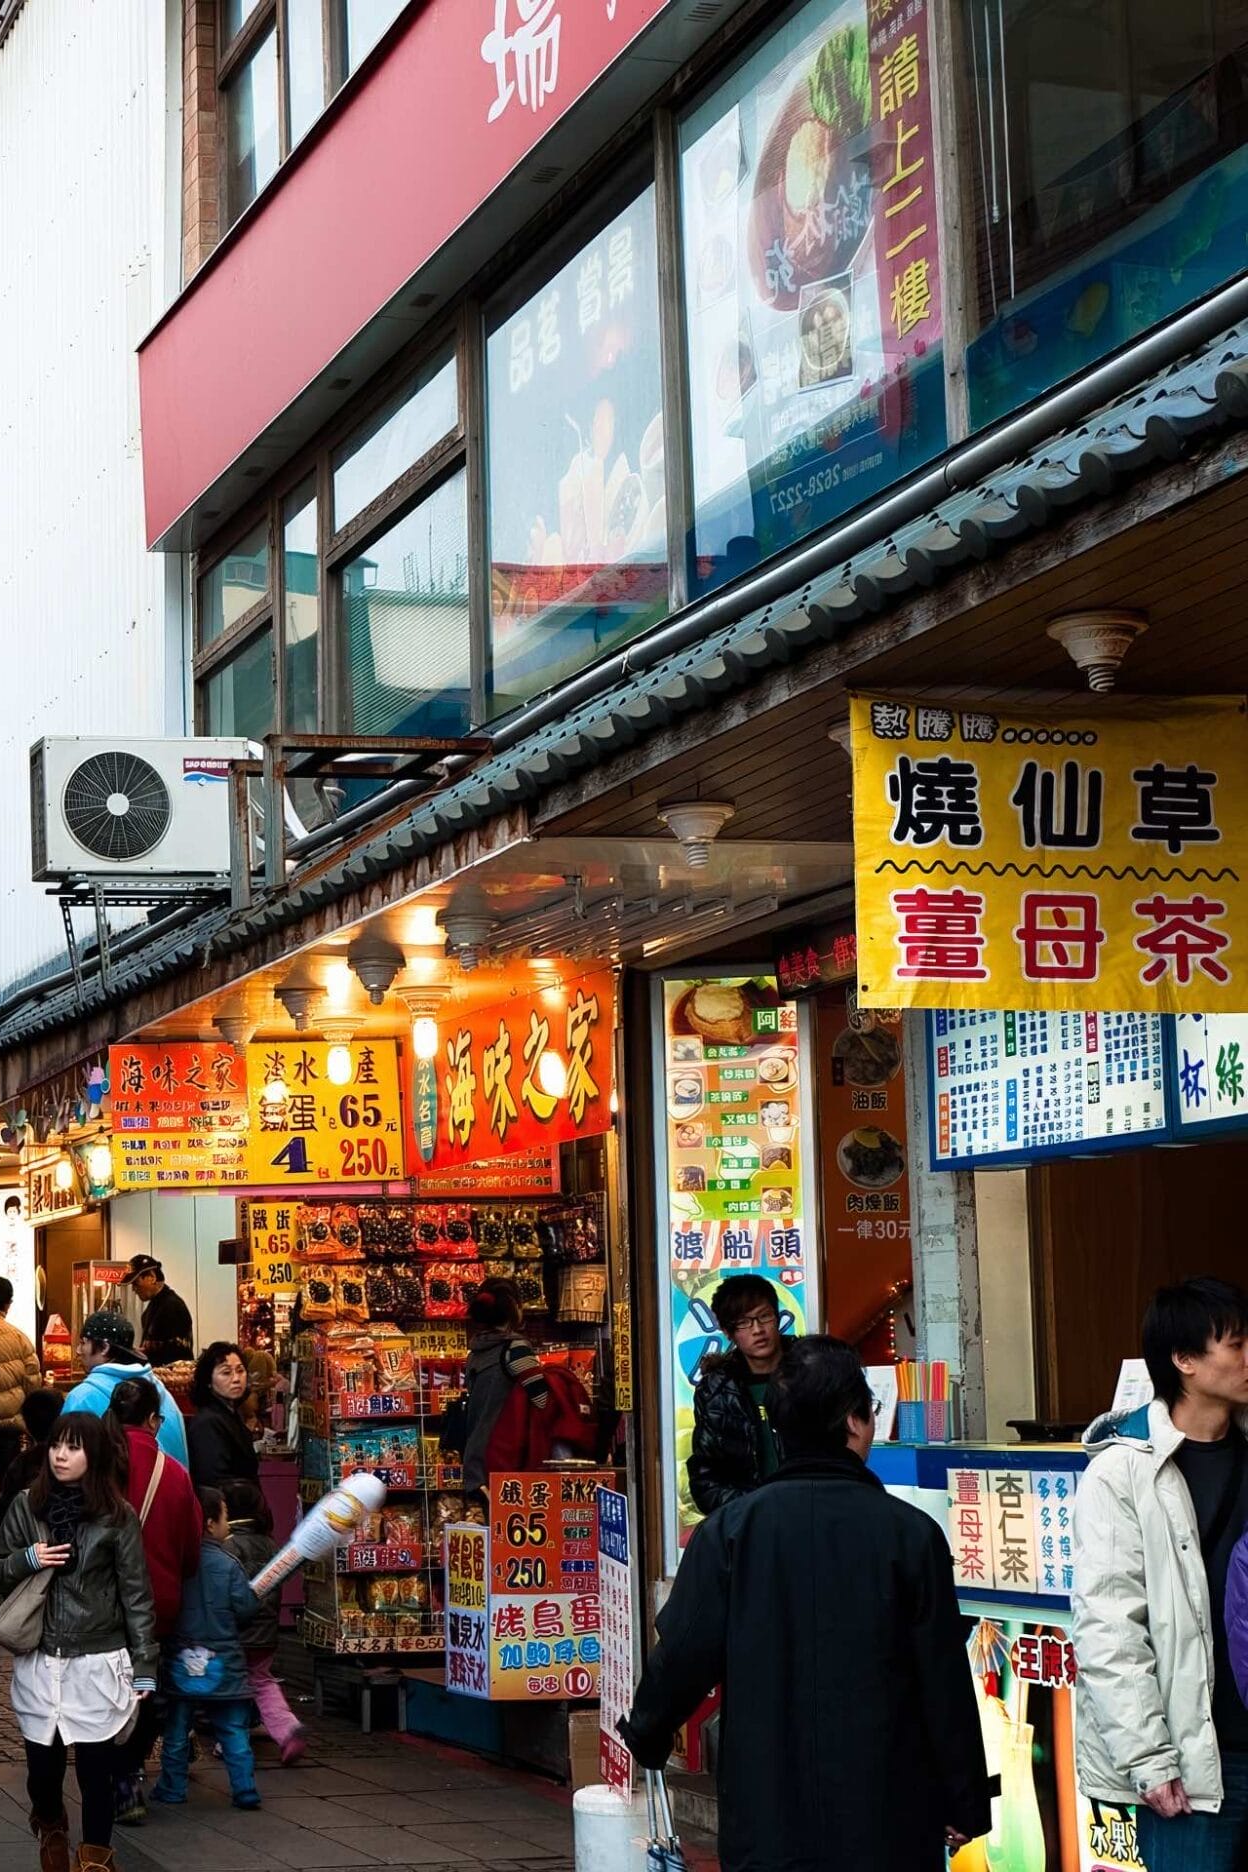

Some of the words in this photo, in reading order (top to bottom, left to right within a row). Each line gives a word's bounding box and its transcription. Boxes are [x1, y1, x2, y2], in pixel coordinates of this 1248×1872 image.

[878, 33, 932, 340] 請上二樓
[888, 755, 1222, 855] 燒仙草
[893, 888, 1231, 984] 薑母茶
[121, 1053, 238, 1095] 海味之家
[264, 1046, 379, 1087] 淡水產
[445, 988, 600, 1146] 海味之家
[675, 1228, 801, 1260] 渡船頭
[506, 1511, 549, 1549] 65
[954, 1471, 986, 1581] 薑母茶
[995, 1472, 1030, 1583] 杏仁茶
[505, 1557, 547, 1589] 250
[491, 1593, 600, 1639] 烤鳥蛋
